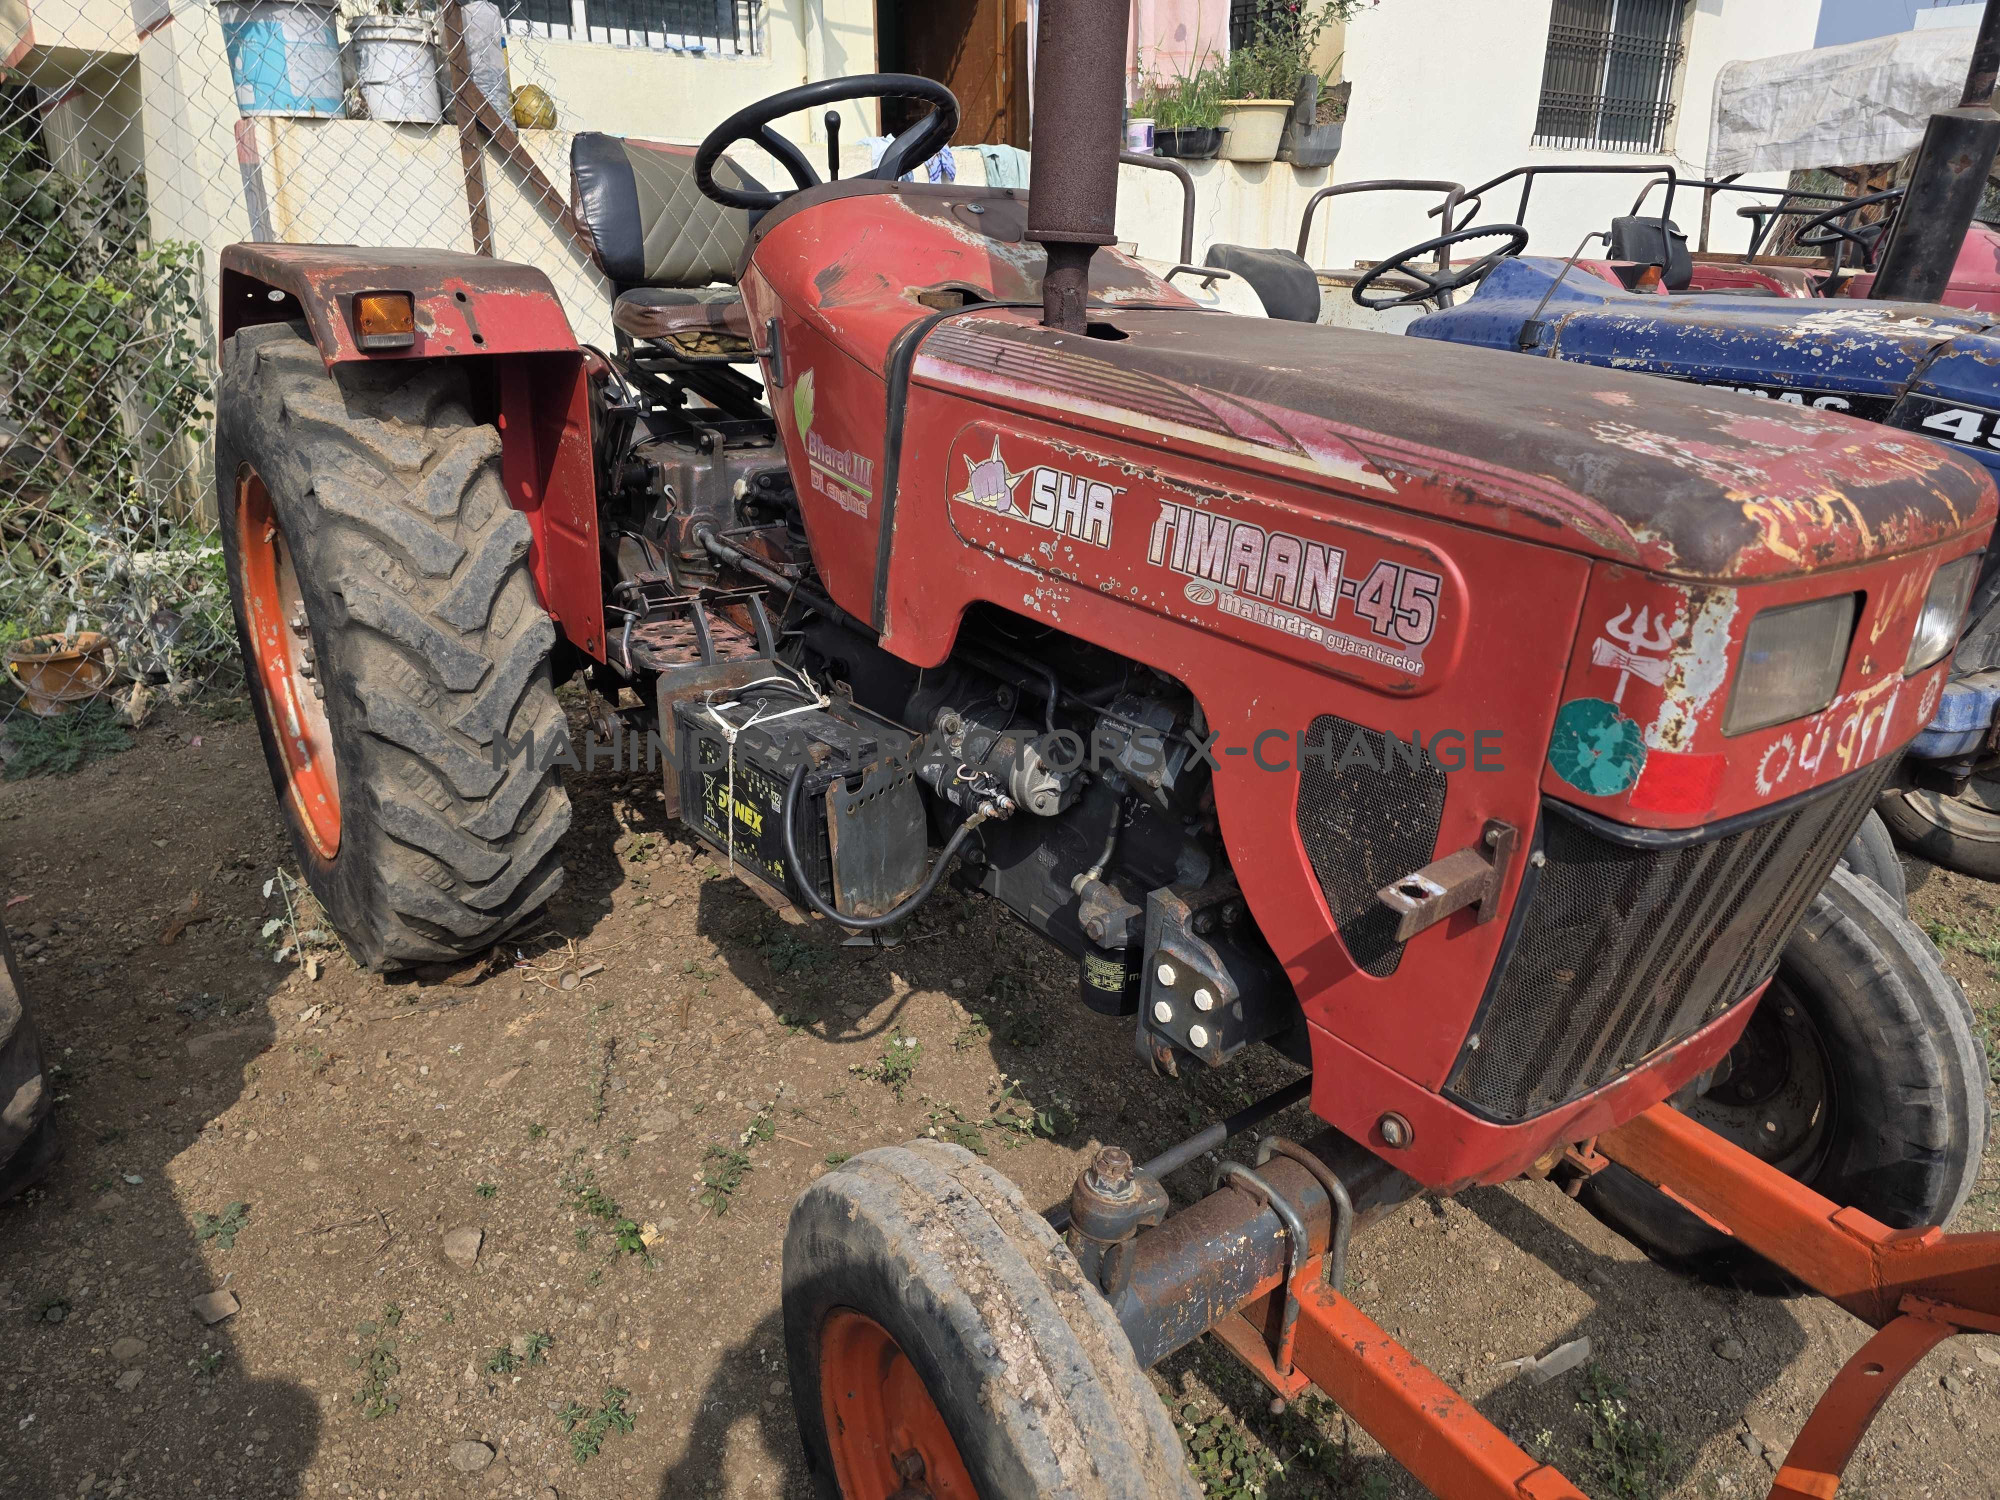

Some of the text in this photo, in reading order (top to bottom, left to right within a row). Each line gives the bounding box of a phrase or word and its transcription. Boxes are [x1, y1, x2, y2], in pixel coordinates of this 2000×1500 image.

[1922, 408, 2000, 449] 4
[808, 432, 851, 476] Bharat
[827, 484, 867, 516] engine
[1327, 632, 1374, 659] gujarat
[1375, 650, 1423, 674] tractor
[706, 801, 715, 819] Pb
